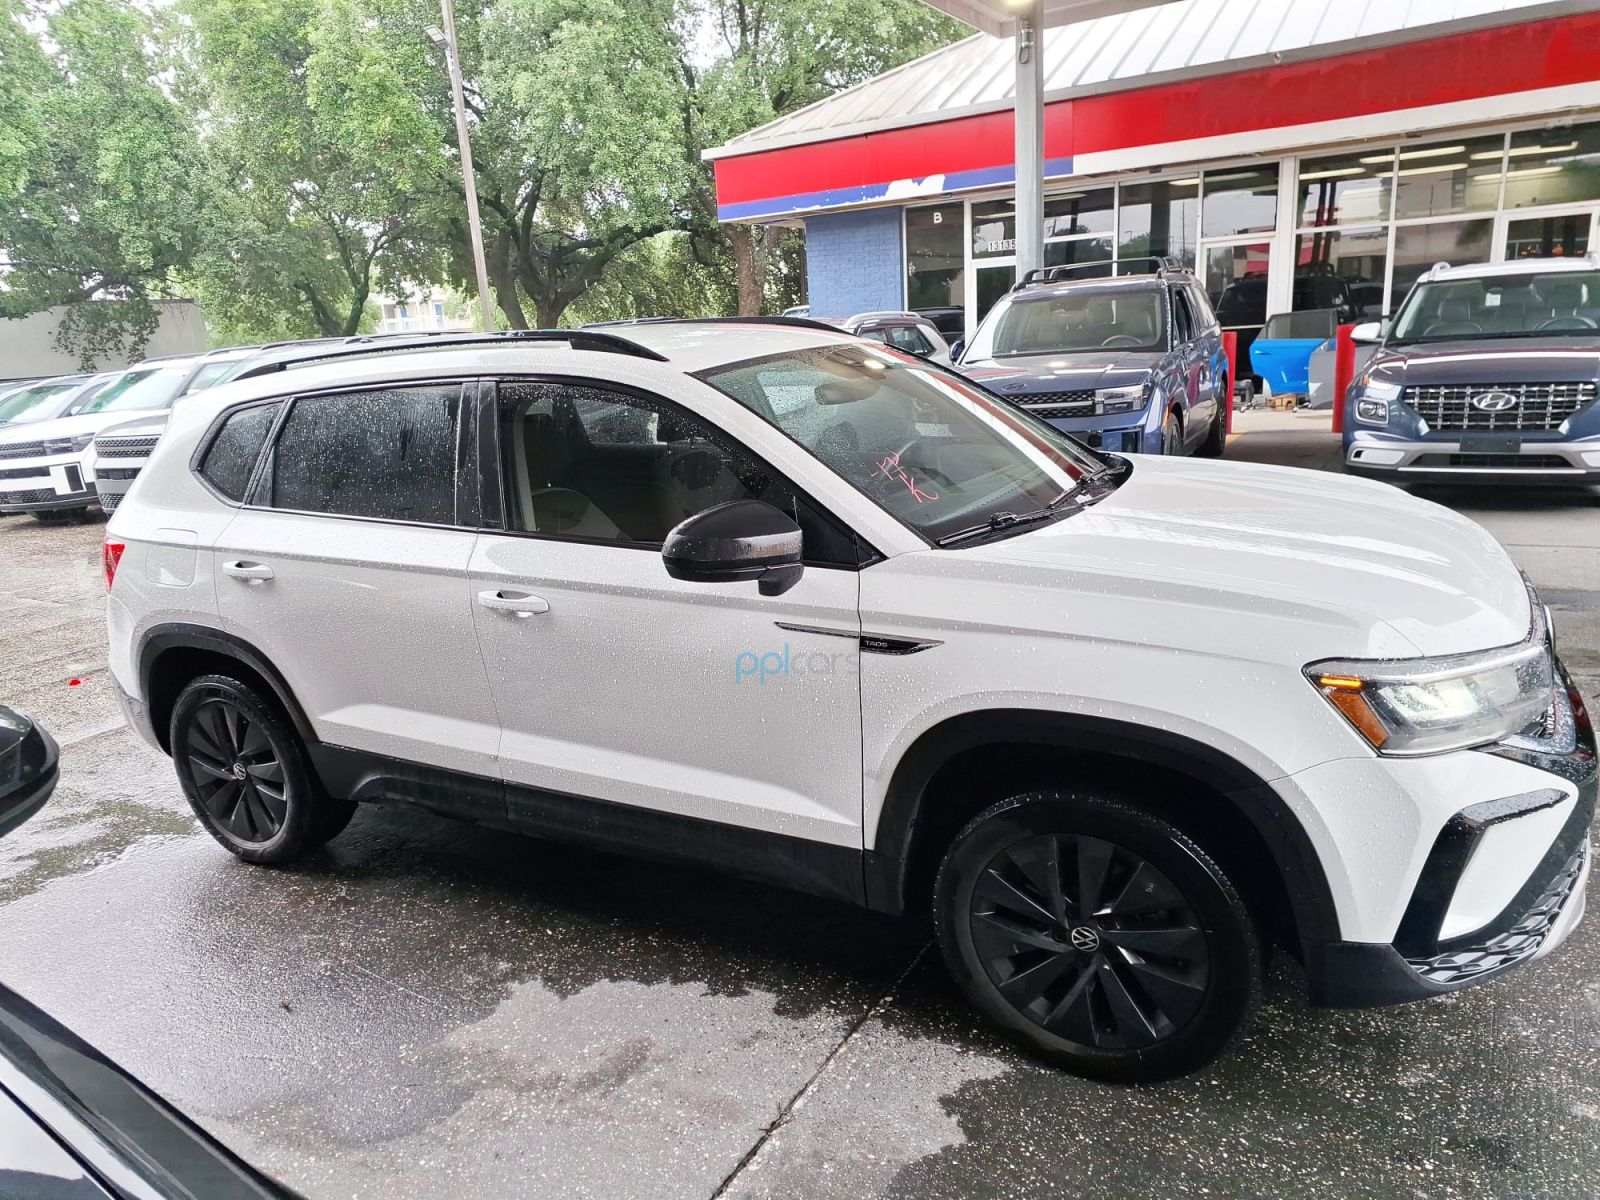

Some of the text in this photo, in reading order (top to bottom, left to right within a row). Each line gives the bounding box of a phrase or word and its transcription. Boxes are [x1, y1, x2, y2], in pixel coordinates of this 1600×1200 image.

[933, 211, 943, 224] B
[989, 238, 1016, 251] 13135
[864, 640, 888, 648] TAOS
